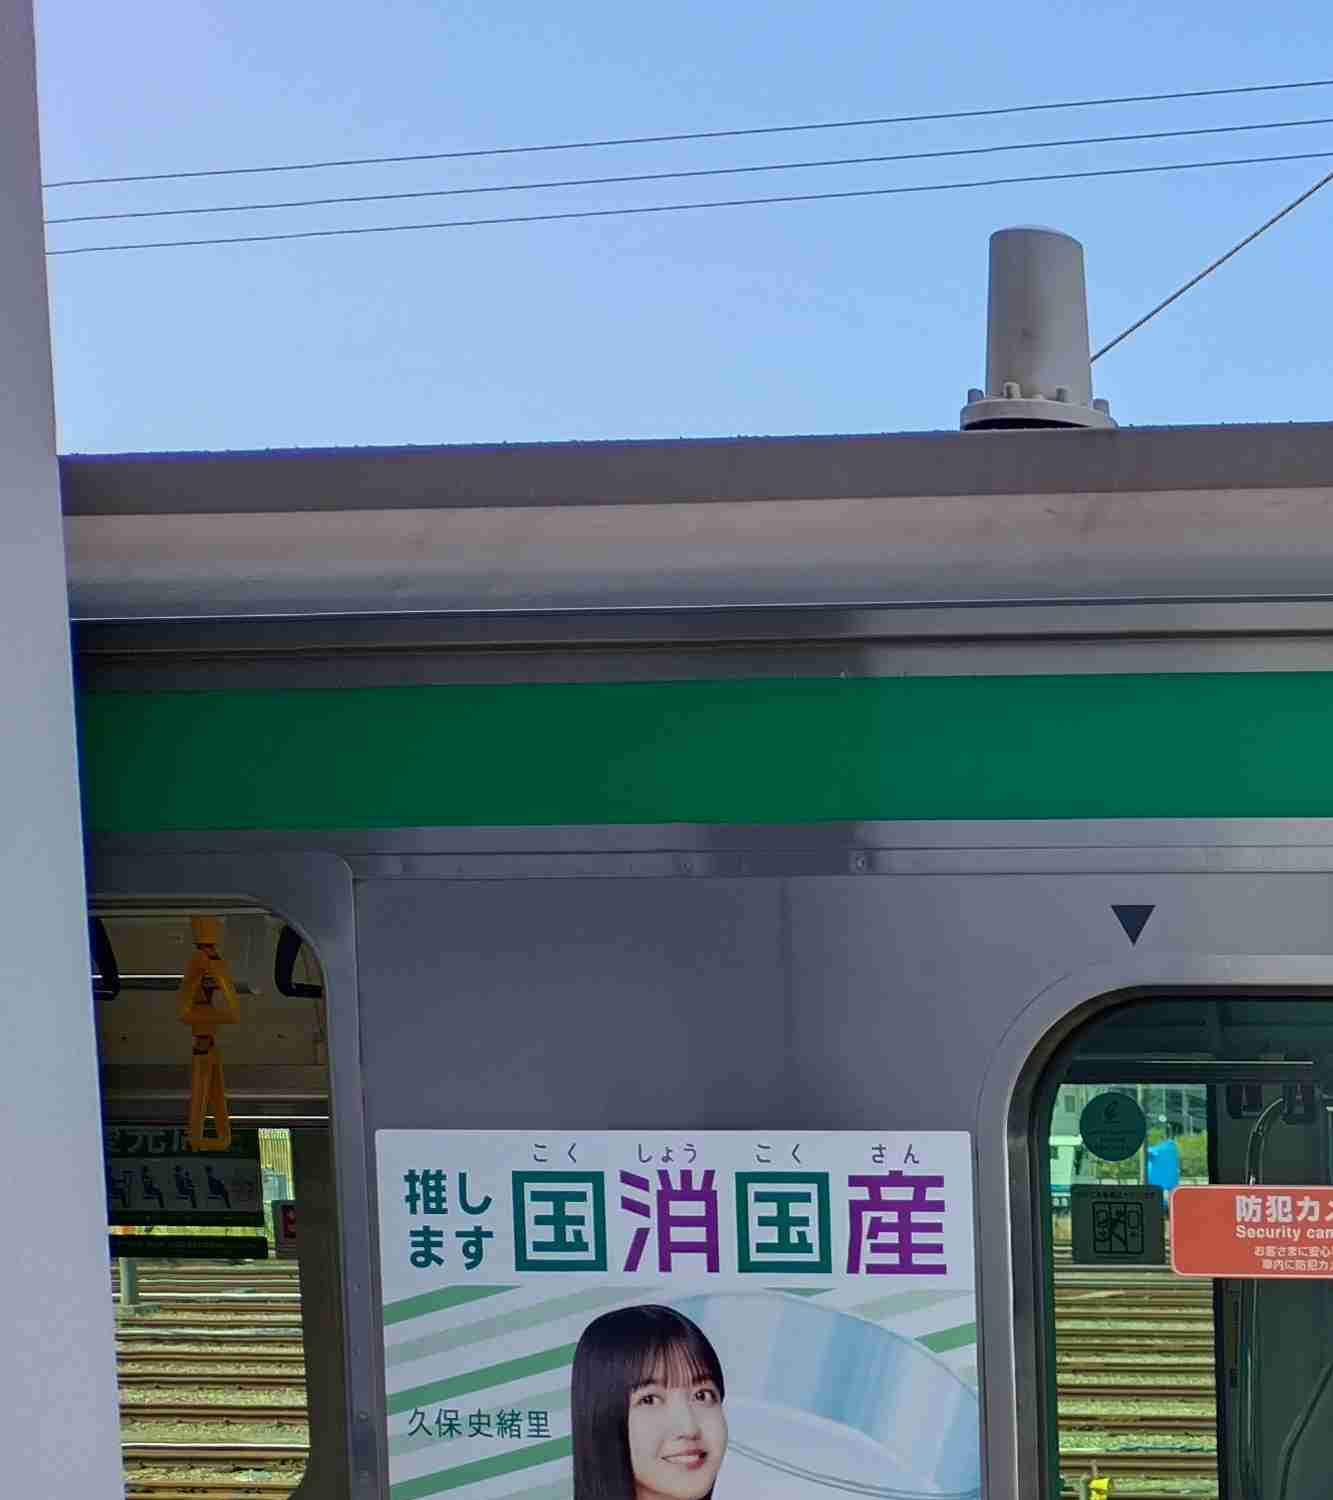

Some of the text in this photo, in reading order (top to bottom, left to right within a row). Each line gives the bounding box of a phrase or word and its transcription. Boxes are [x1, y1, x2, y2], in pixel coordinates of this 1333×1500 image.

[533, 1143, 920, 1164] こく しょう こく さん
[403, 1169, 493, 1216] 推し
[511, 1169, 947, 1275] 国消国産
[1235, 1225, 1300, 1241] Security
[409, 1225, 494, 1271] ます
[408, 1407, 552, 1439] 久保史緒里
